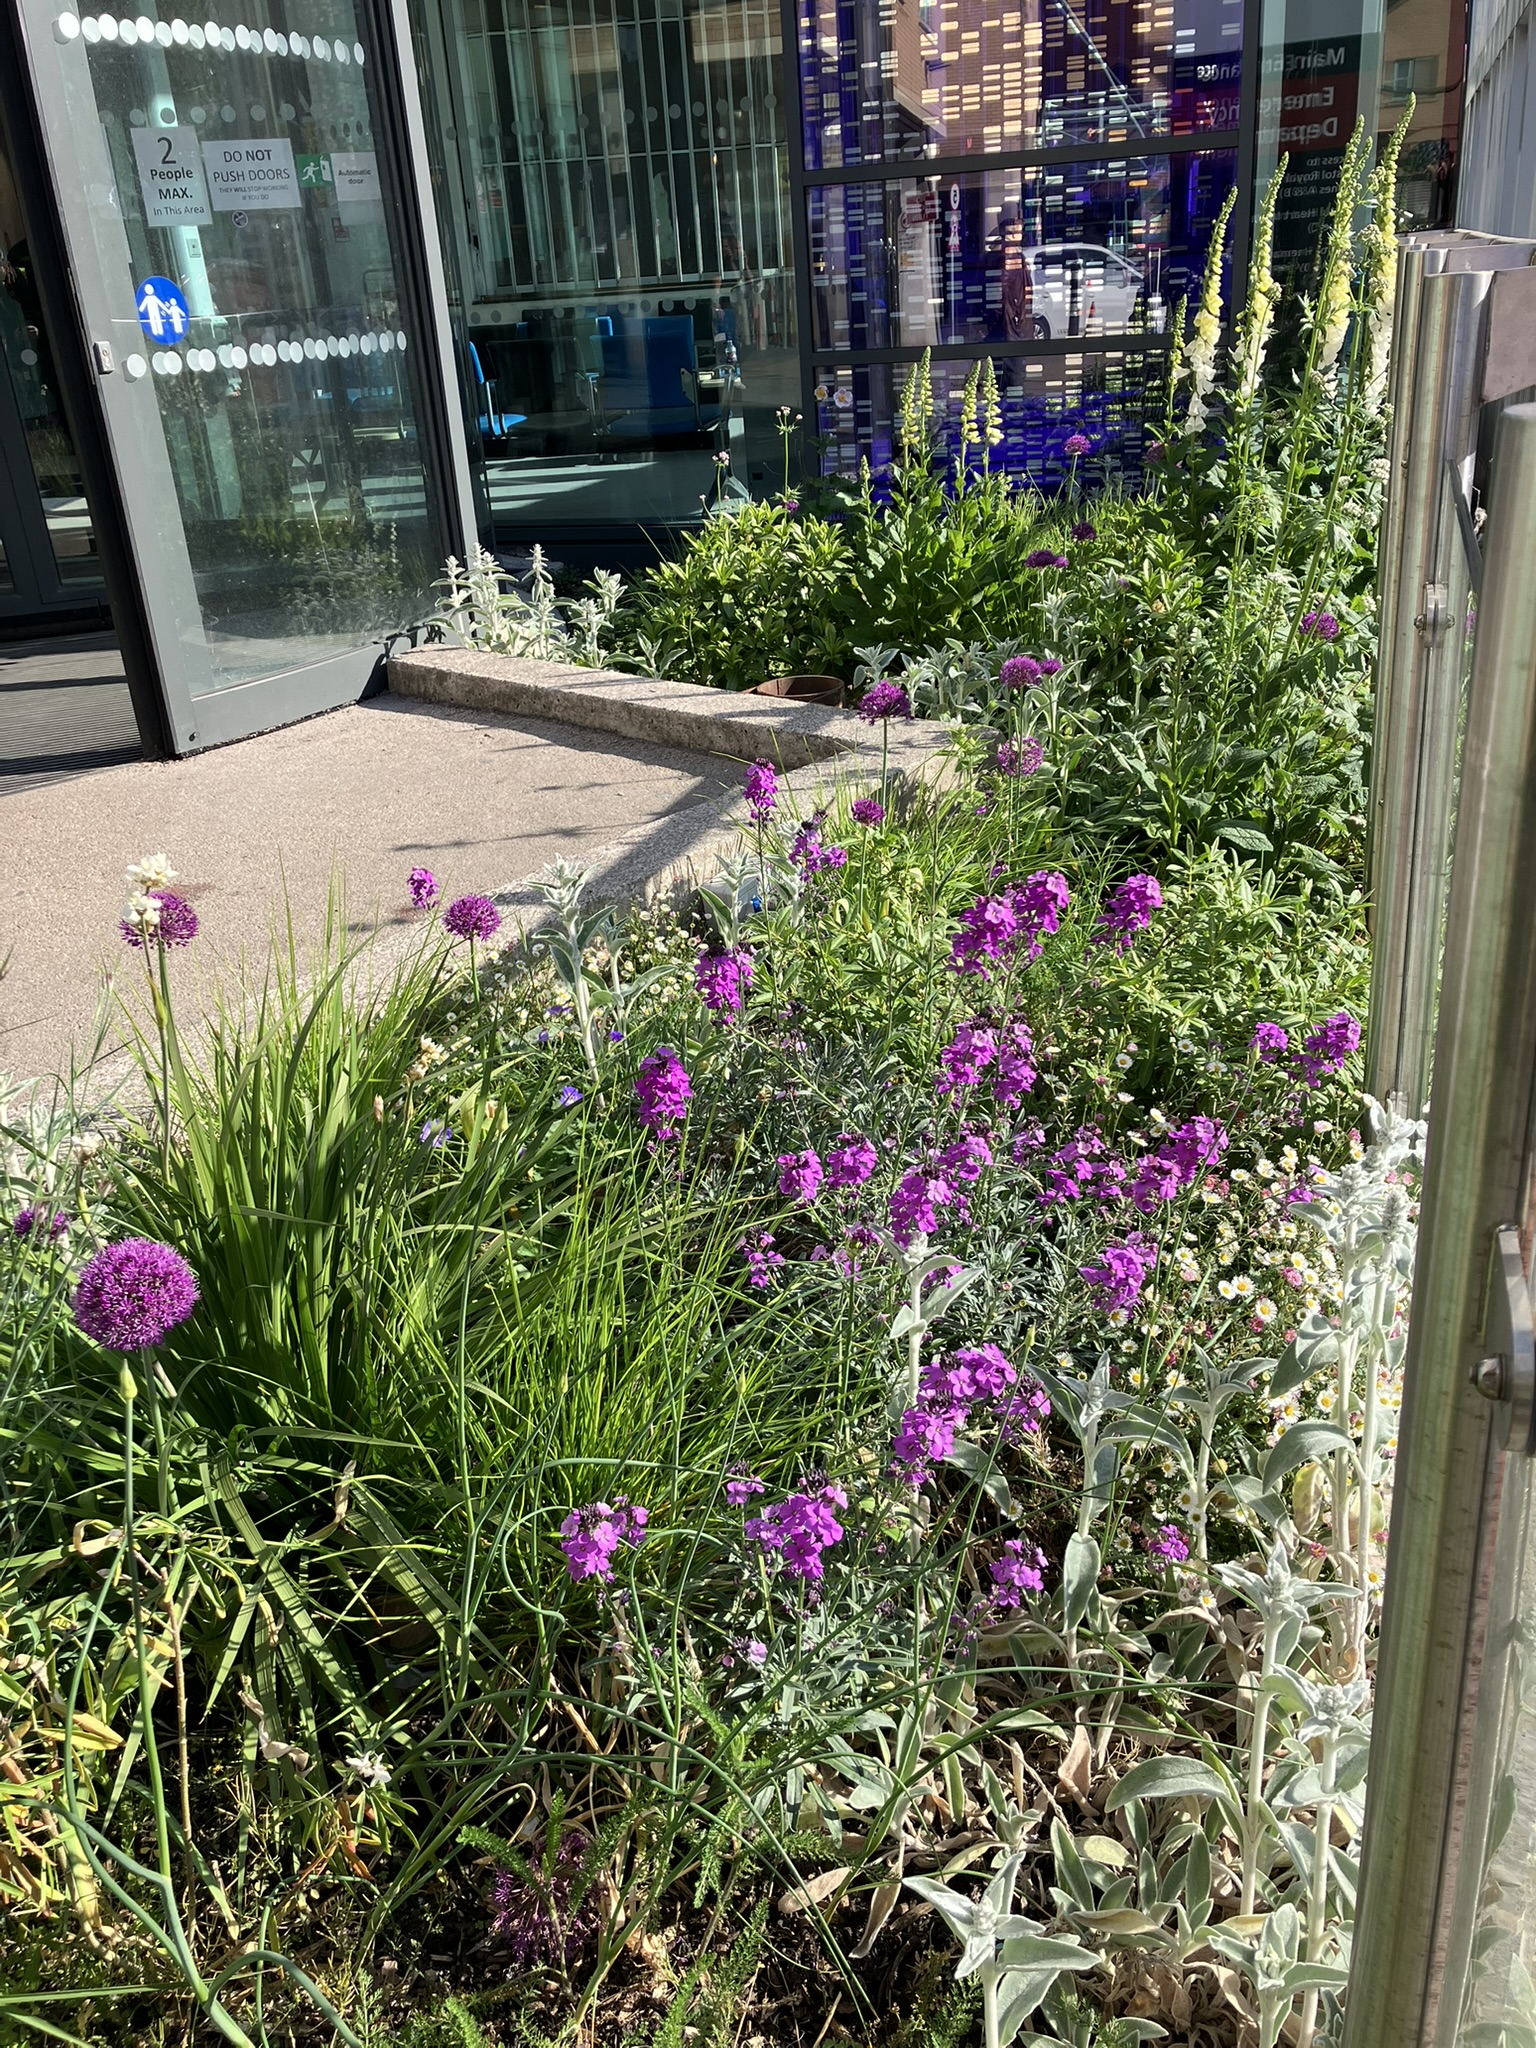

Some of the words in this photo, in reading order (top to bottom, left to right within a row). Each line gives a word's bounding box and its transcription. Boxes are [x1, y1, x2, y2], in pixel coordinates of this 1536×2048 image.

[157, 136, 177, 165] 2
[223, 150, 242, 163] DO
[245, 149, 272, 162] NOT
[150, 166, 194, 182] People
[213, 170, 246, 183] PUSH
[248, 168, 290, 181] DOORS
[158, 187, 193, 200] MAX.
[153, 207, 163, 216] In
[163, 206, 182, 215] This
[184, 205, 205, 214] Area
